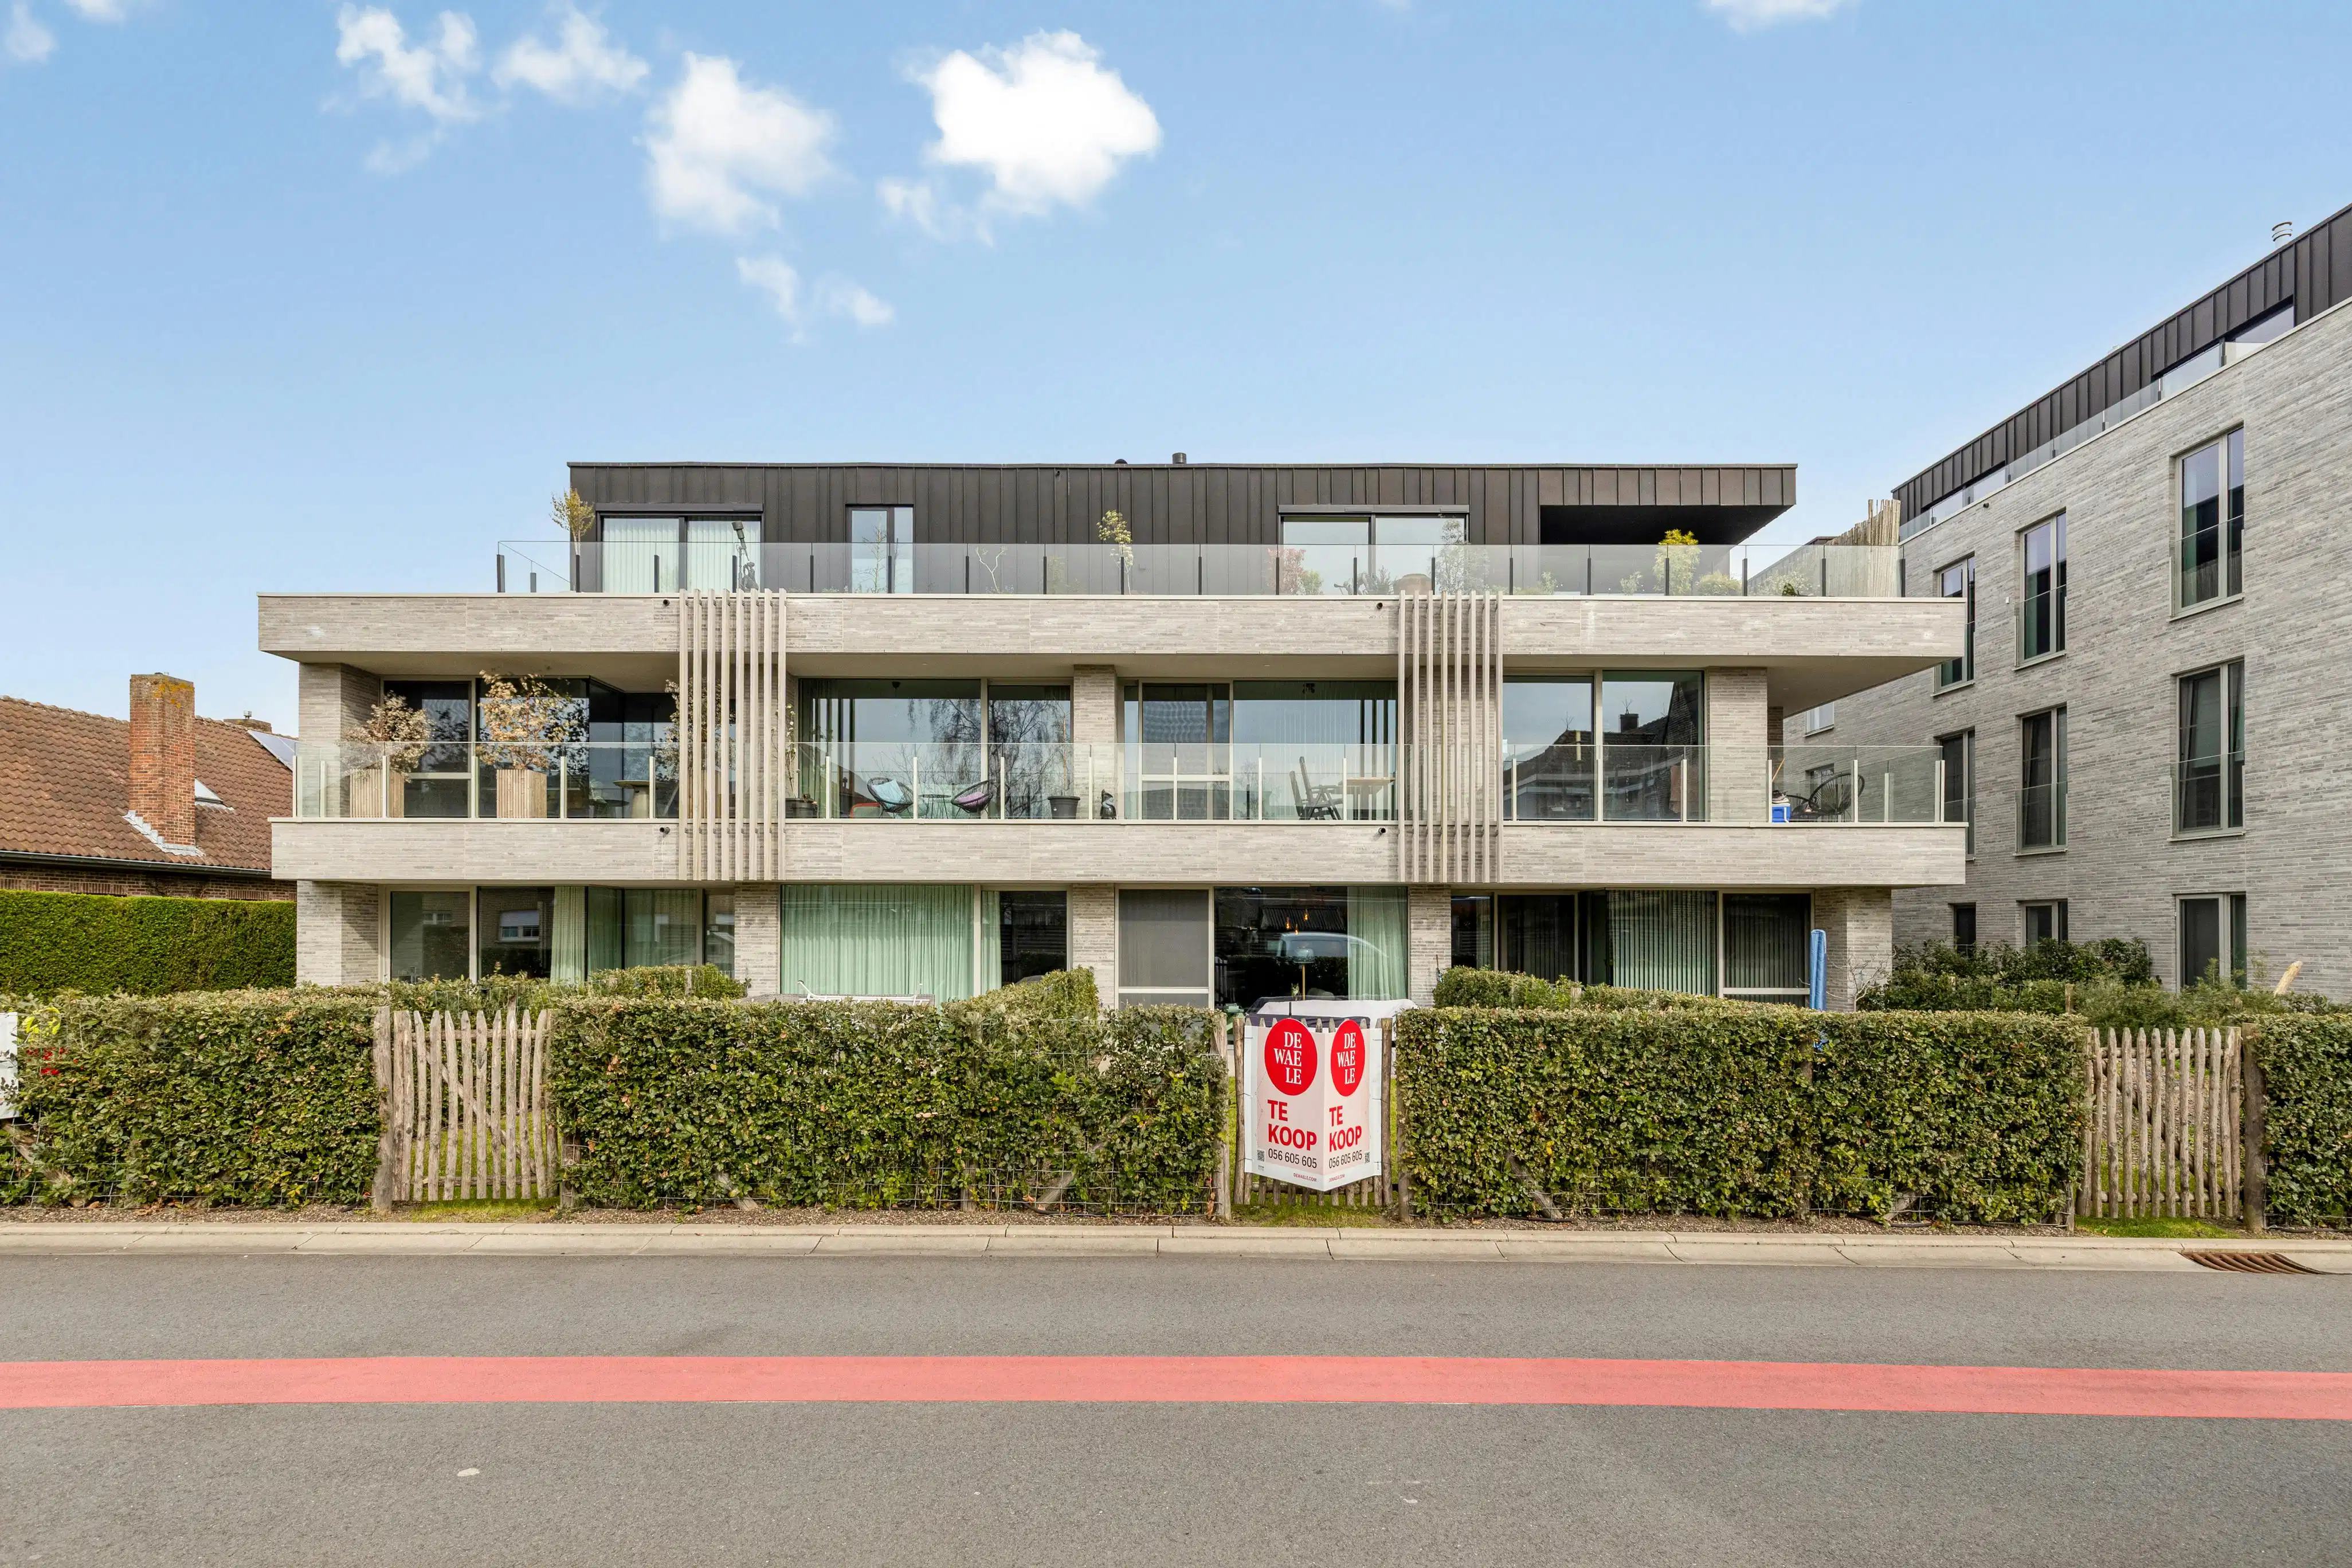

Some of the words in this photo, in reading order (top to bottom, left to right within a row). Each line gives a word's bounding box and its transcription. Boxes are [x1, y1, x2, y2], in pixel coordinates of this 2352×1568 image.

[1284, 1032, 1302, 1049] DE
[1344, 1032, 1356, 1049] DE
[1273, 1048, 1302, 1067] WAE
[1336, 1050, 1356, 1067] WAE
[1285, 1067, 1302, 1084] LE
[1344, 1068, 1355, 1084] LE
[1268, 1099, 1288, 1122] TE
[1329, 1106, 1343, 1127] TE
[1268, 1123, 1317, 1151] KOOP
[1329, 1126, 1362, 1152] KOOP
[1268, 1148, 1283, 1161] 056
[1285, 1152, 1299, 1165] 605
[1302, 1156, 1317, 1169] 605
[1329, 1156, 1339, 1169] 056
[1340, 1153, 1351, 1166] 605
[1352, 1150, 1362, 1162] 605
[1293, 1173, 1317, 1182] DEWAELE.COM
